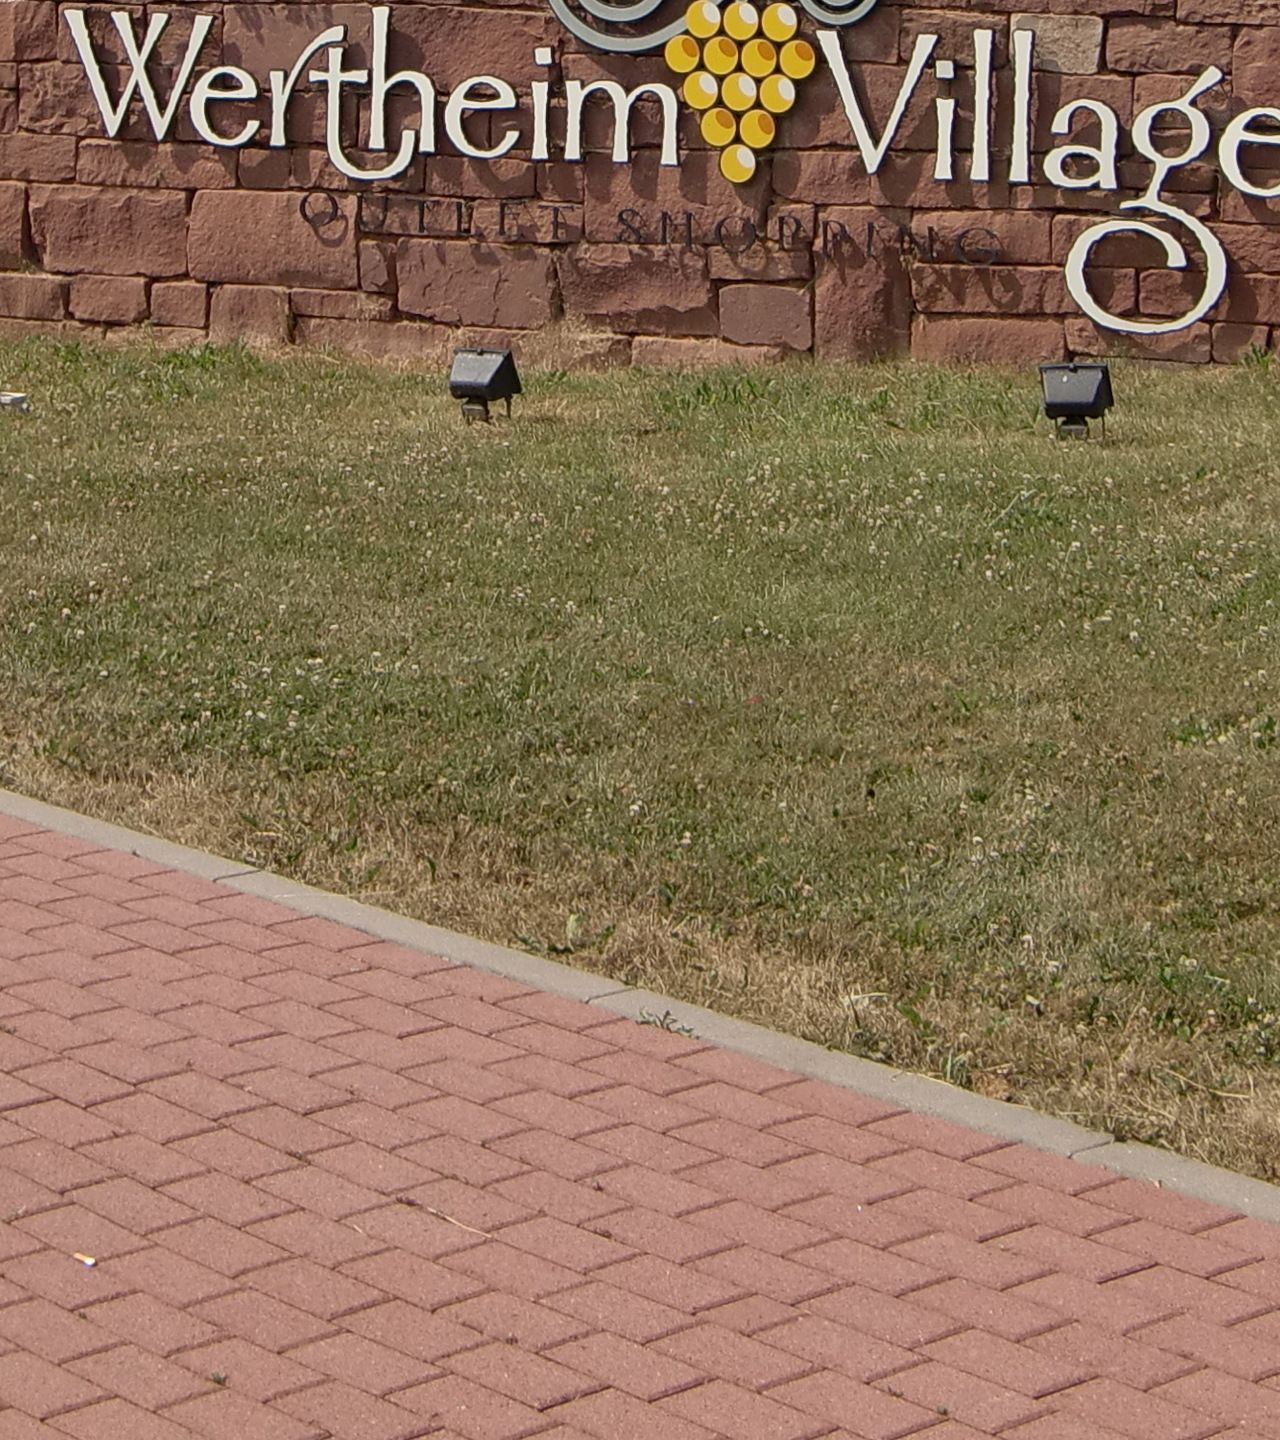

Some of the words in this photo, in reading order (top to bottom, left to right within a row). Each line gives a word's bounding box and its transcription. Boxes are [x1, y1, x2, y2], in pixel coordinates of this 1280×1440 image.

[63, 5, 680, 180] Wertheim
[299, 191, 579, 240] OUTLET
[615, 208, 1002, 266] SHOPPING
